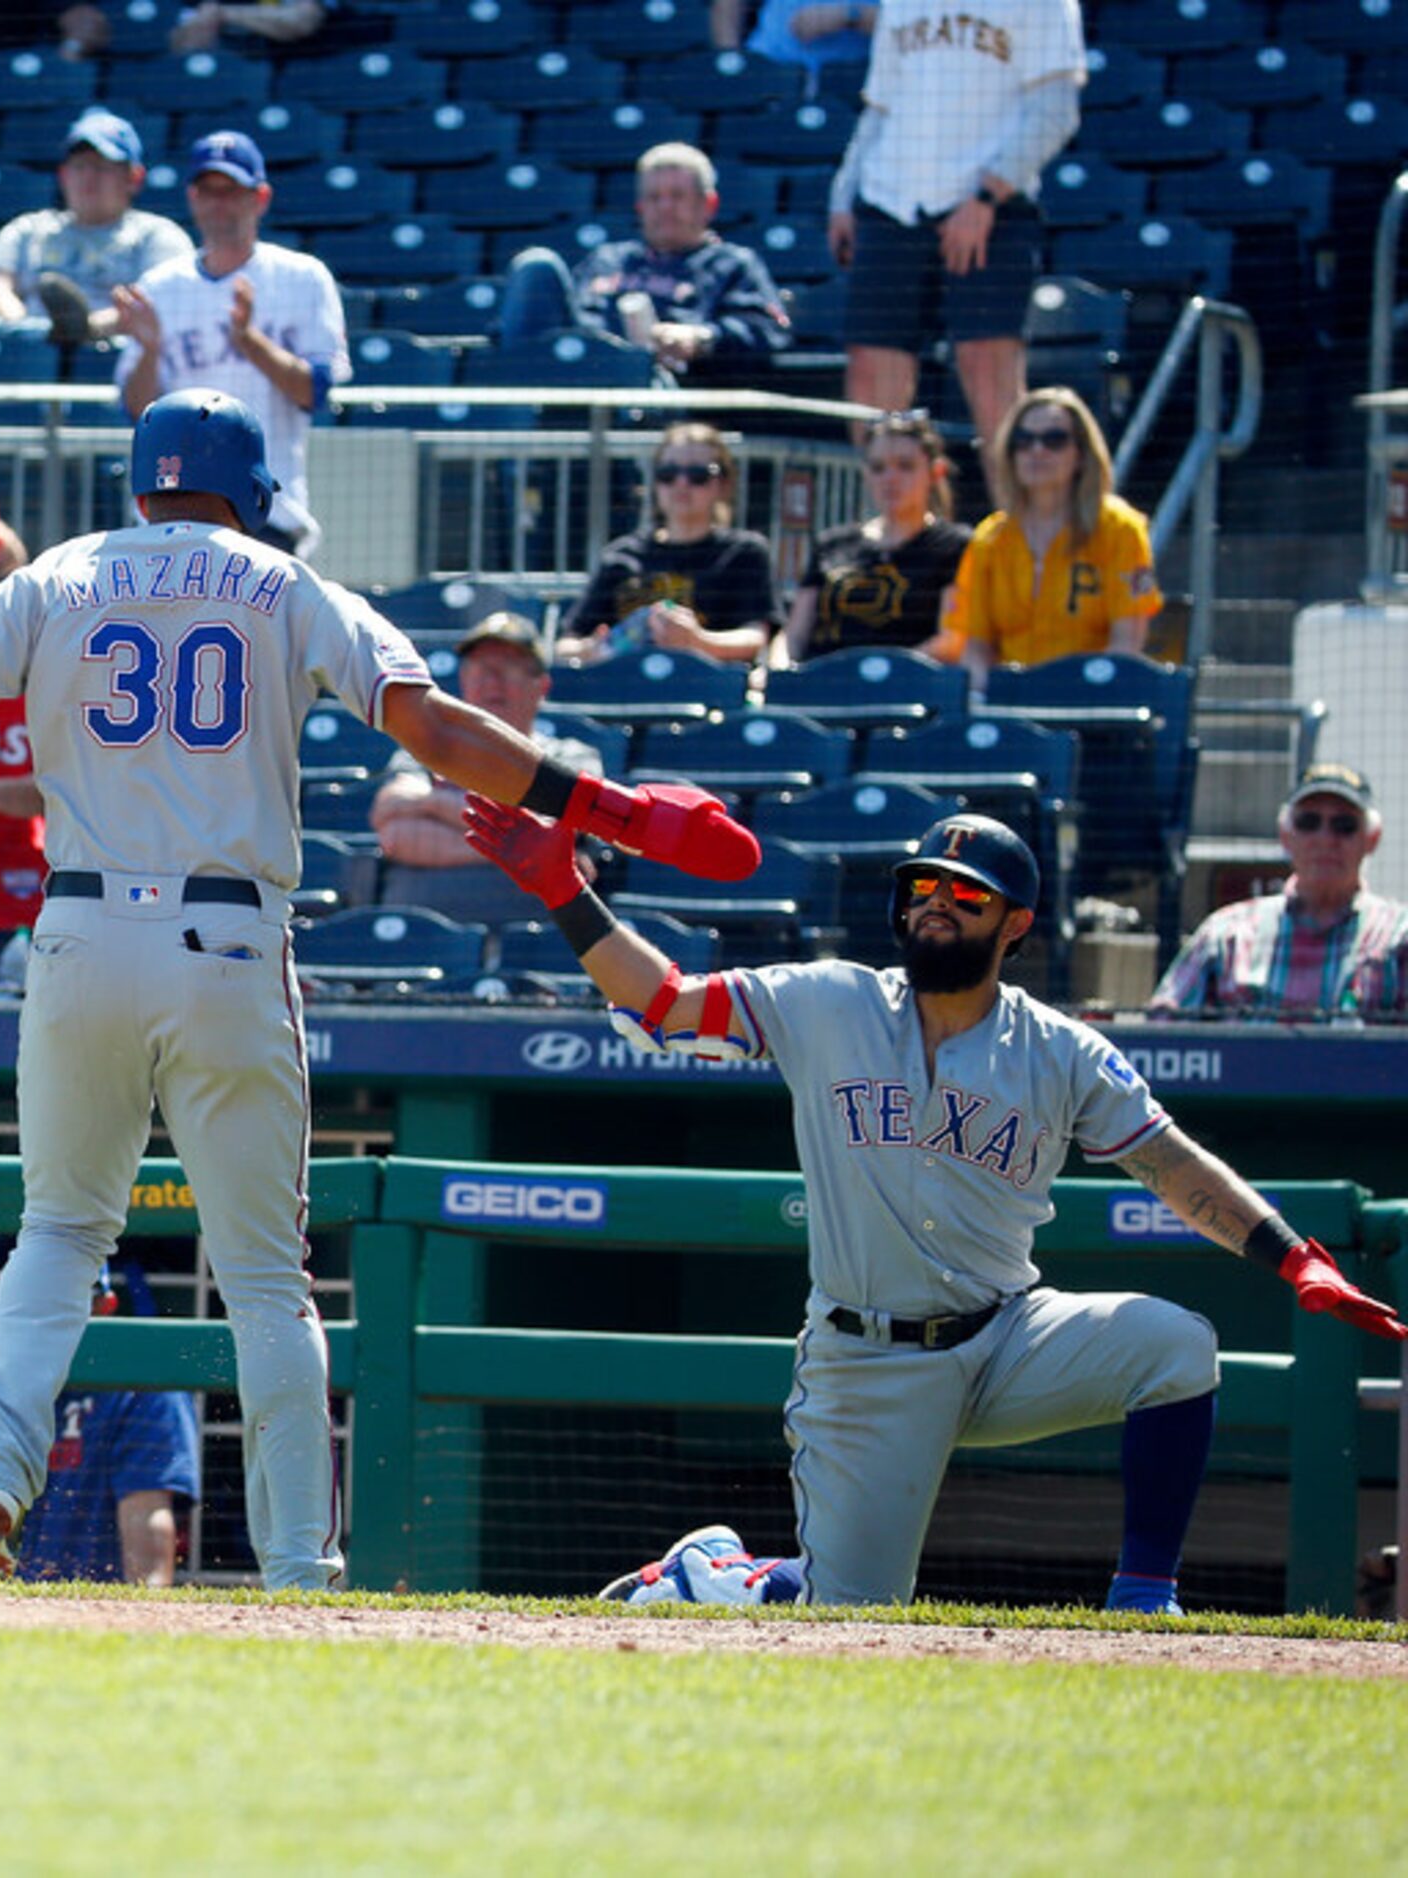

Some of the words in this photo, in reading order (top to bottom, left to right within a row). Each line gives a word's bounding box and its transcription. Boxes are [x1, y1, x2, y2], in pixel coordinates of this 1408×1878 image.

[65, 548, 292, 617] MAZARA
[81, 619, 253, 754] 30
[943, 824, 976, 860] T
[444, 1181, 604, 1221] GEICO
